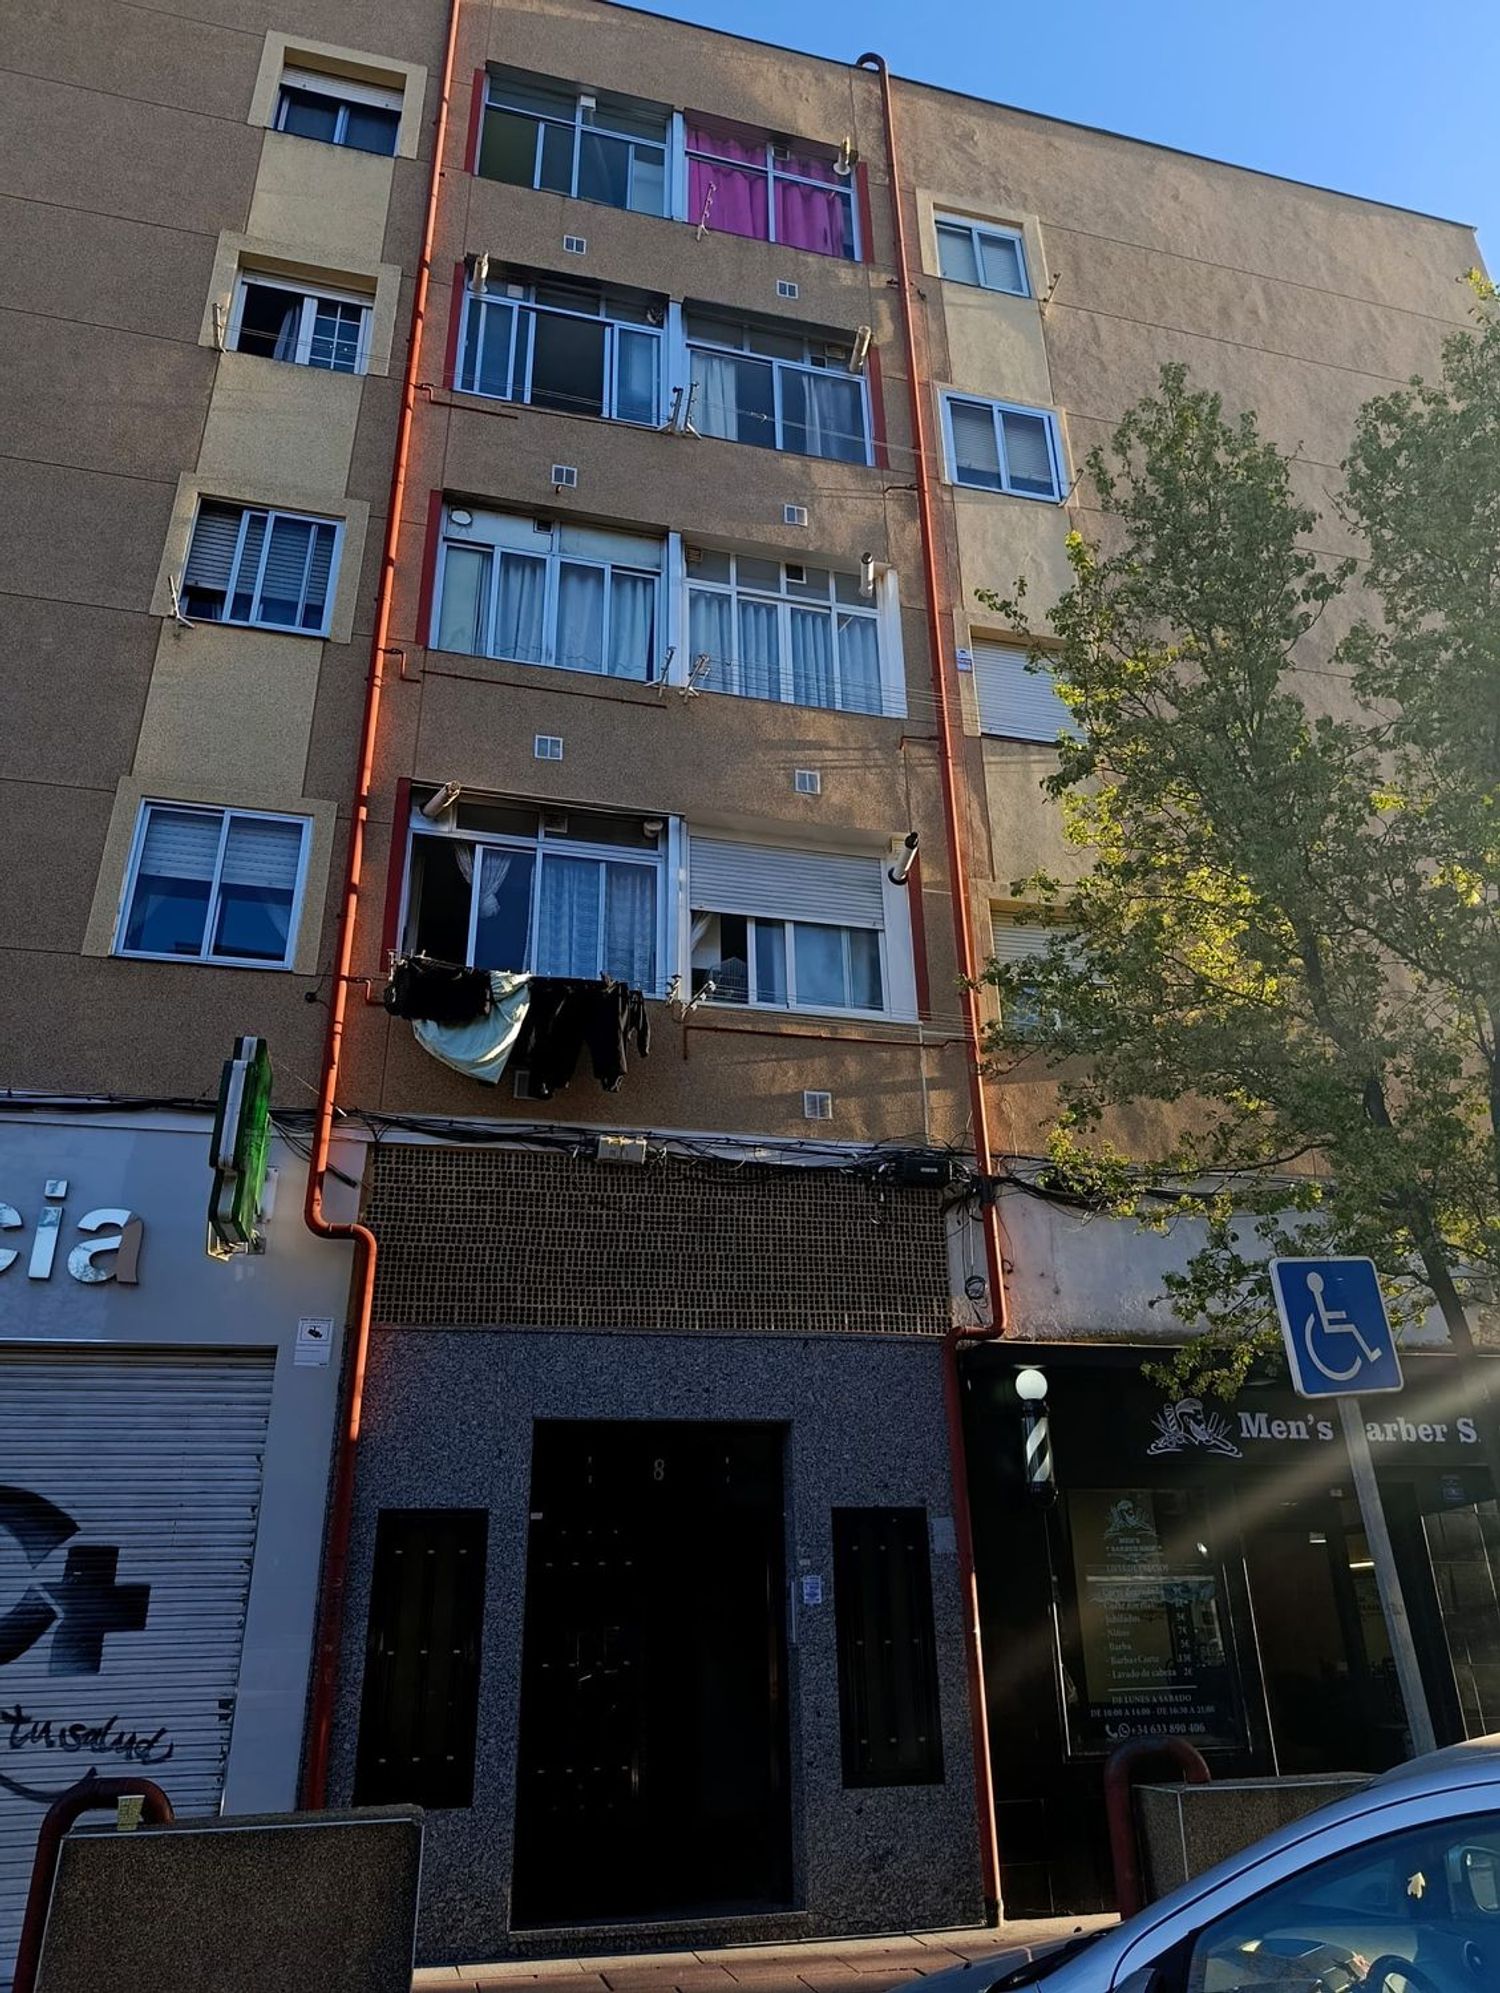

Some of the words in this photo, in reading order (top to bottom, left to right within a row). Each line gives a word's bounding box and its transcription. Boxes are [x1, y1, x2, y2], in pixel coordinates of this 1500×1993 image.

[1237, 1411, 1334, 1441] Men's
[1366, 1416, 1448, 1443] arber
[653, 1458, 665, 1481] 8
[1112, 1695, 1123, 1705] DE
[1124, 1695, 1151, 1704] LUNES
[1090, 1709, 1101, 1718] DE
[0, 1704, 55, 1749] tu
[1150, 1723, 1168, 1734] 633
